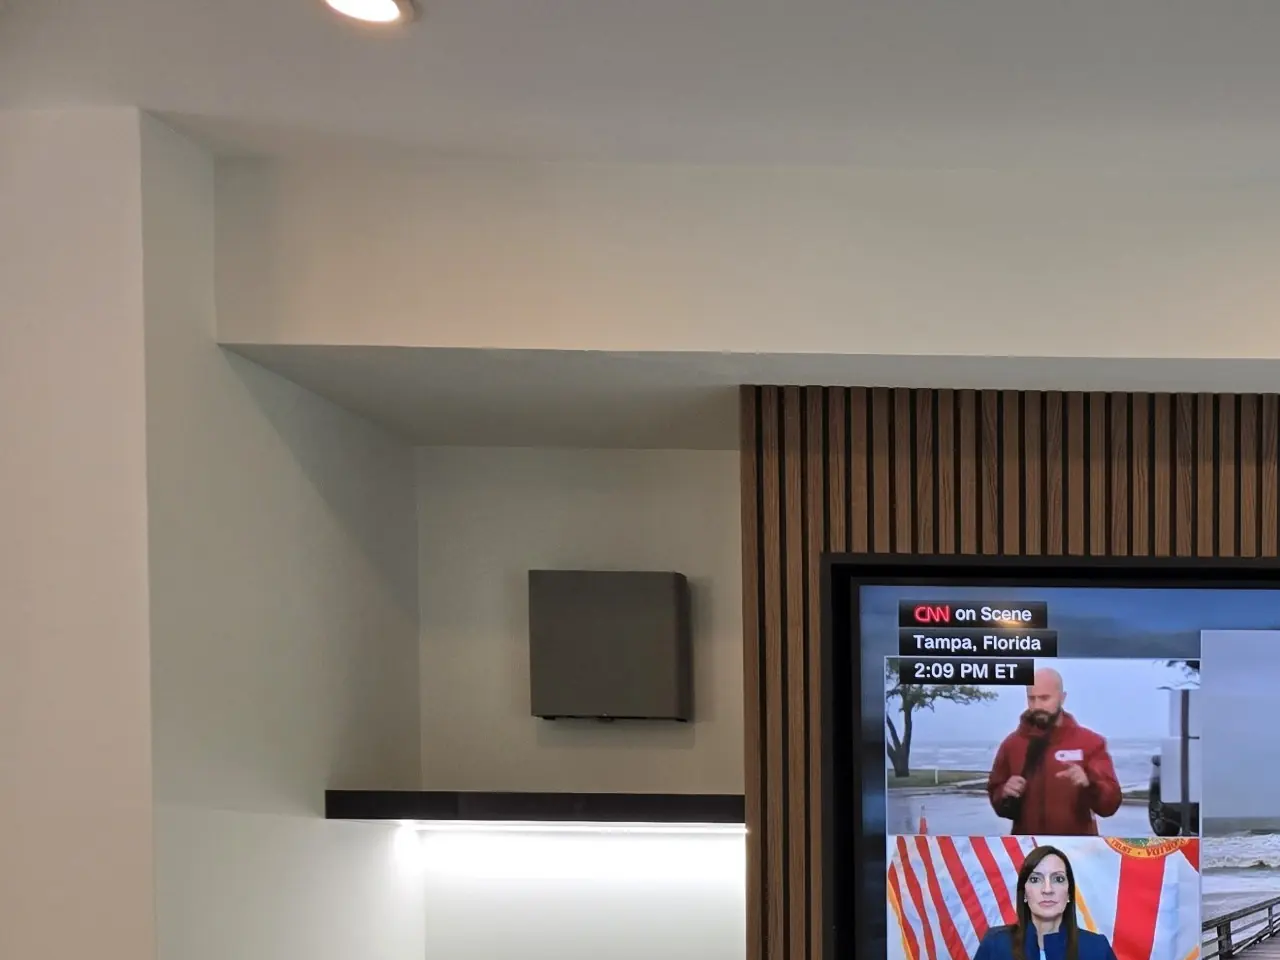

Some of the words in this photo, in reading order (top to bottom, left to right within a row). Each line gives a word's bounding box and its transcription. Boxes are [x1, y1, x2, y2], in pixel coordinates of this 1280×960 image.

[914, 606, 949, 622] CNN
[955, 608, 976, 621] on
[980, 606, 1032, 622] Scene
[912, 635, 977, 652] Tampa,
[983, 636, 1041, 650] Florida
[914, 663, 954, 679] 2:09
[961, 664, 989, 679] PM
[995, 664, 1017, 679] ET
